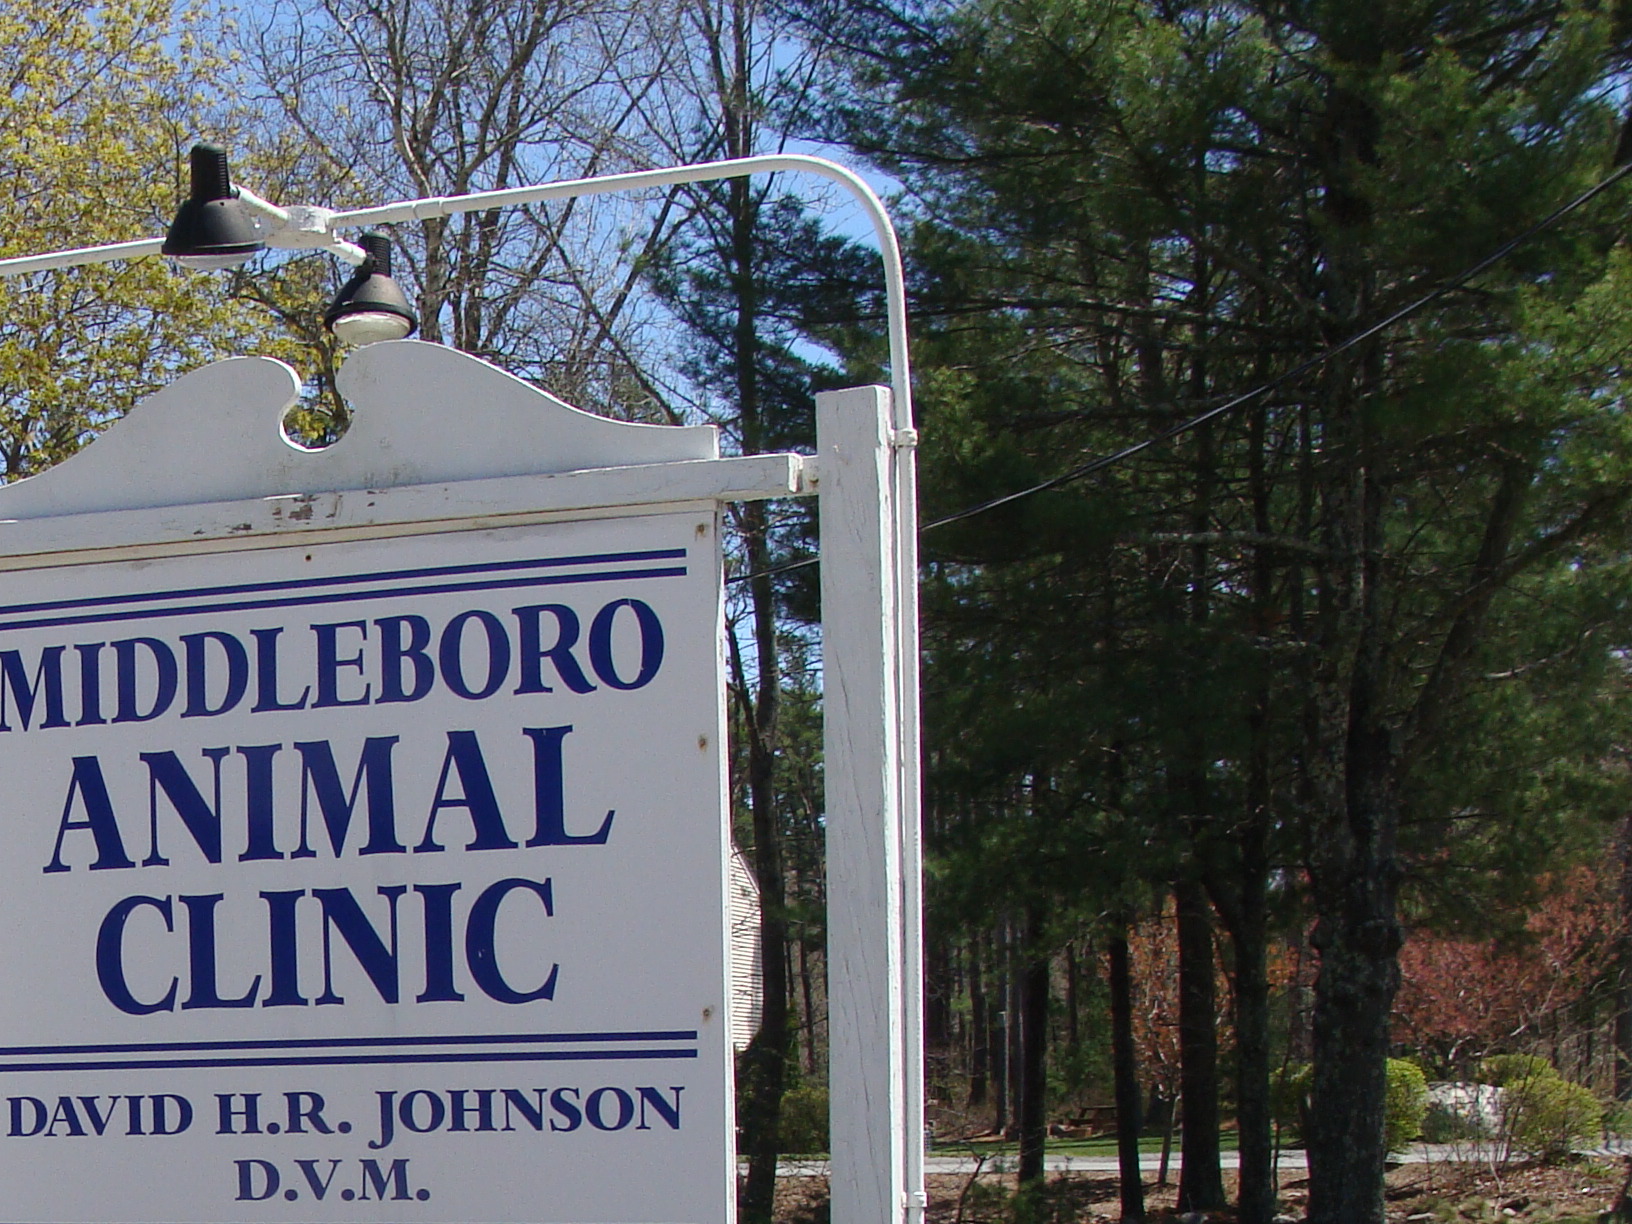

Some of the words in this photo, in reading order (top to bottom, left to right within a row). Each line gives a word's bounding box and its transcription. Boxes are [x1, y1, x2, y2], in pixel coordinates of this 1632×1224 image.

[42, 725, 616, 874] ANIMAL
[95, 877, 560, 1016] CLINIC
[5, 1093, 194, 1138] DAVID
[213, 1091, 353, 1136] H.R.
[367, 1085, 686, 1150] JOHNSON
[232, 1158, 431, 1202] D.V.M.
